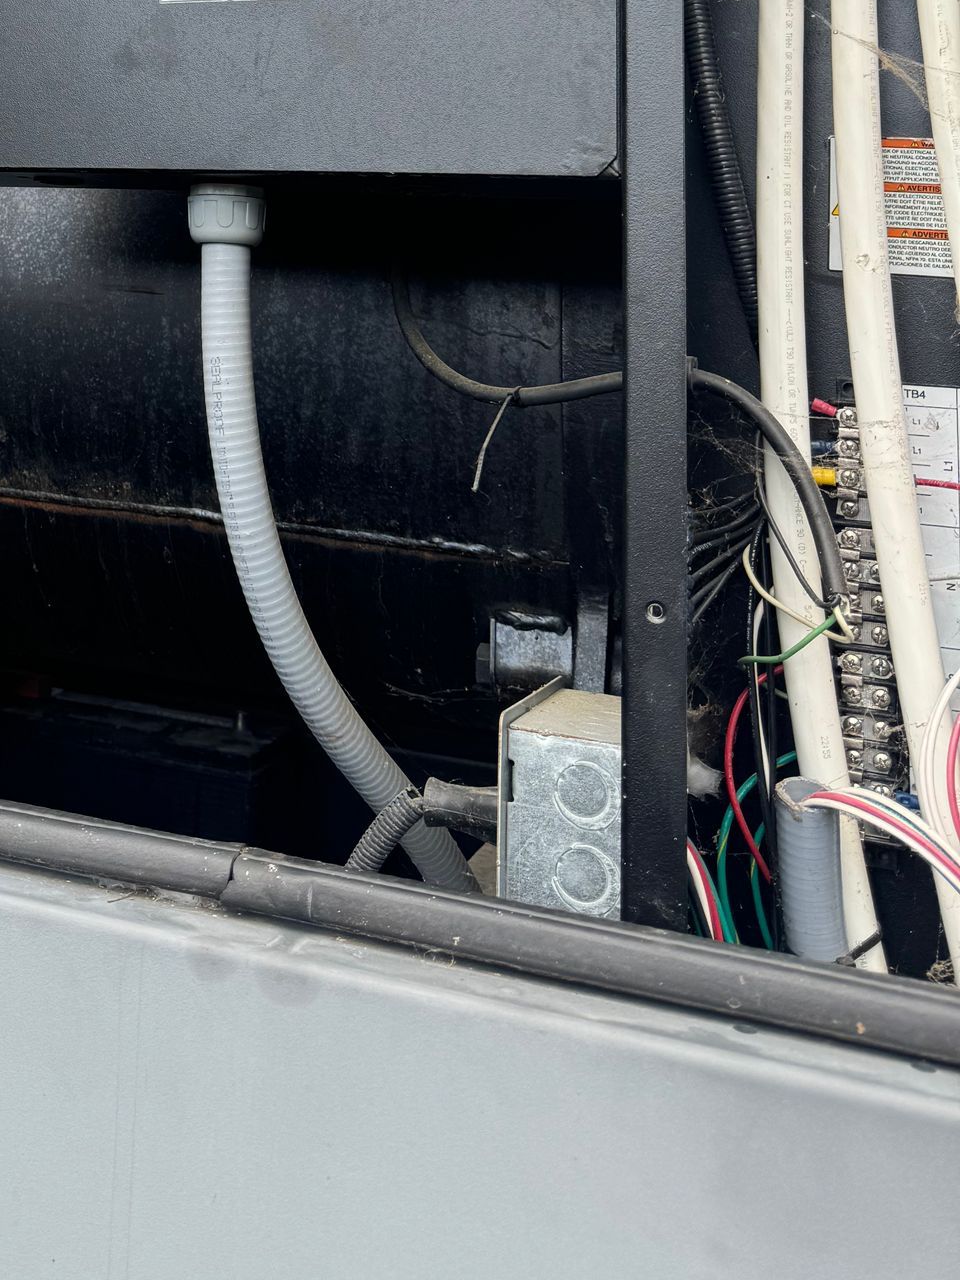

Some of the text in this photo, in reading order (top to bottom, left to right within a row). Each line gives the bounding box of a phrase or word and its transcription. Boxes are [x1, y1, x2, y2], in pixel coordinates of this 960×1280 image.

[785, 52, 792, 60] OR
[784, 64, 792, 96] GASOLINE
[784, 131, 792, 168] RESISTANT
[784, 184, 792, 196] FOR
[784, 212, 792, 226] USE
[912, 231, 948, 239] ADVERTE
[784, 228, 792, 262] SUNLIGHT
[785, 266, 793, 304] RESISTANT
[211, 357, 224, 436] SEALPROOF
[904, 388, 926, 399] TB4
[912, 446, 922, 454] L1
[944, 461, 952, 472] L1
